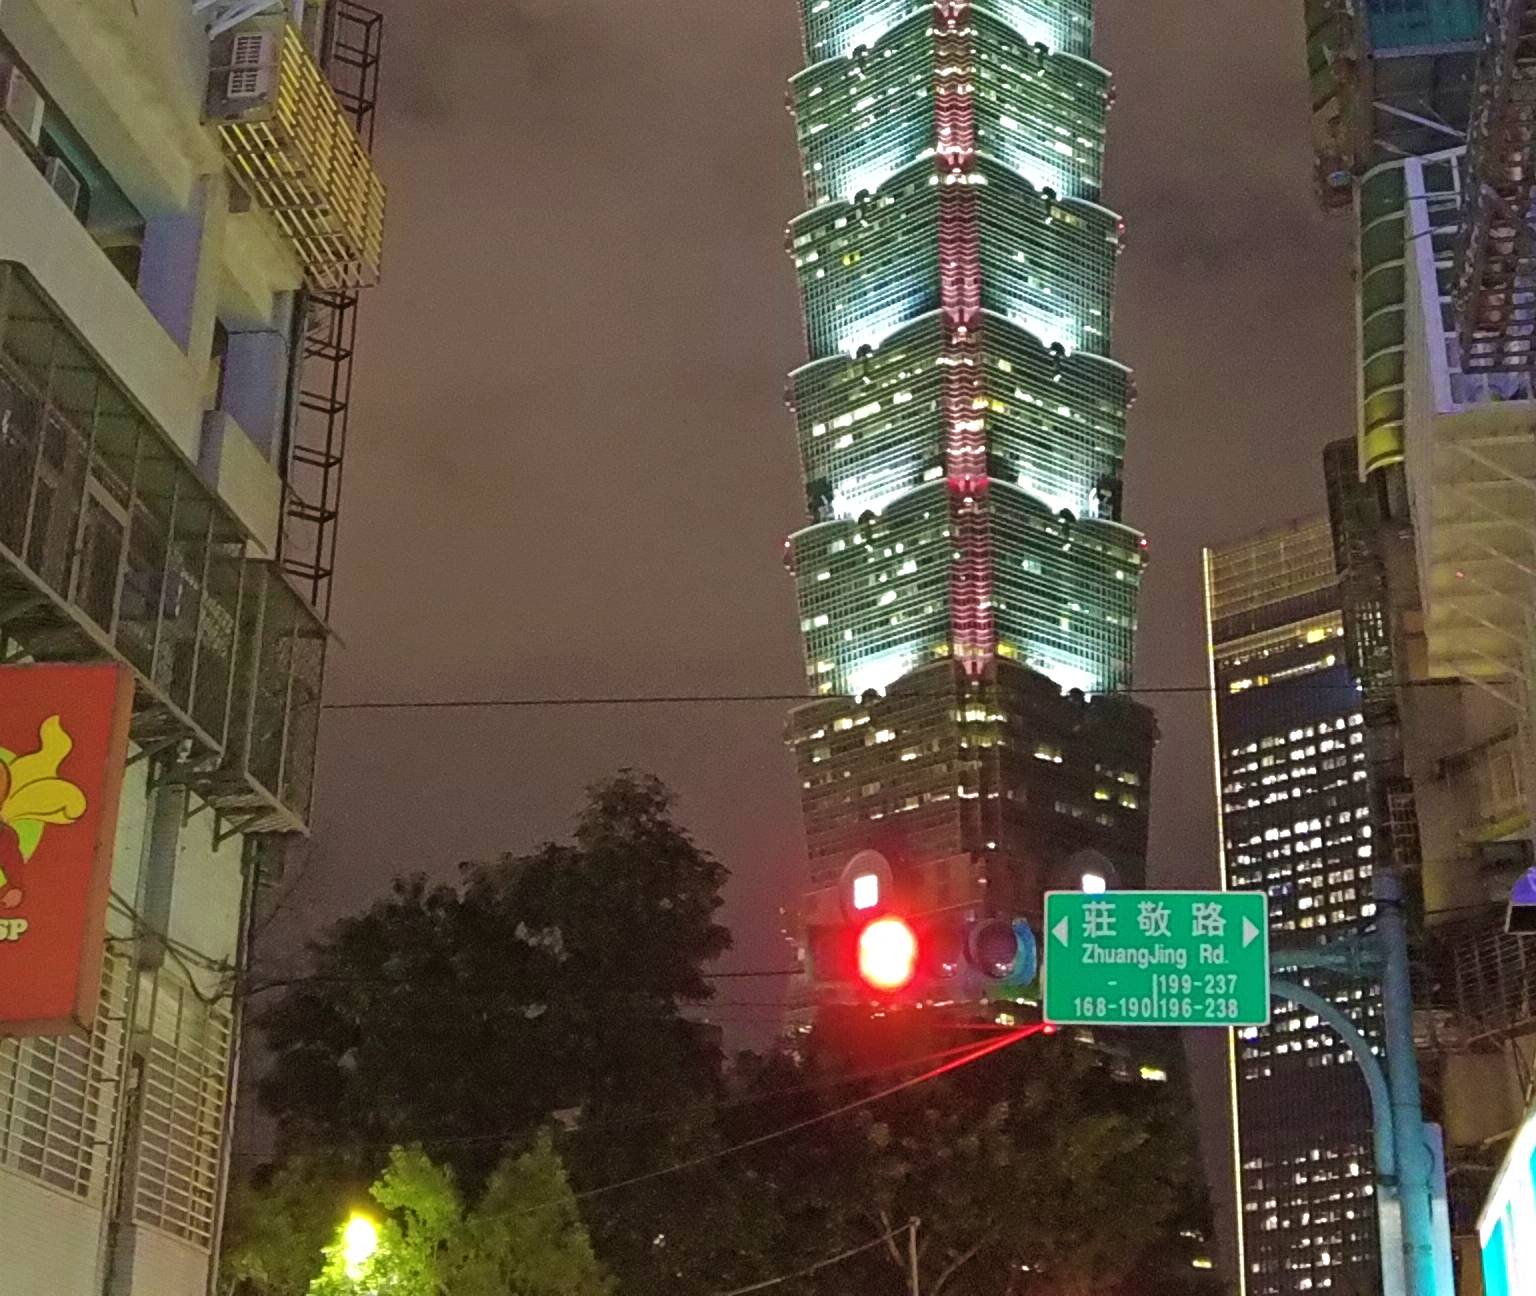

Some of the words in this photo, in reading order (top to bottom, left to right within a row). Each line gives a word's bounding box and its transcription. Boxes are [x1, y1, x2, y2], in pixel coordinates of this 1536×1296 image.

[1081, 901, 1226, 937] 莊敬路
[1081, 944, 1187, 969] ZhuangJing
[1199, 944, 1229, 964] Rd.
[1159, 974, 1238, 994] 199-237
[1074, 997, 1151, 1017] 168-190
[1159, 998, 1239, 1018] 196-238
